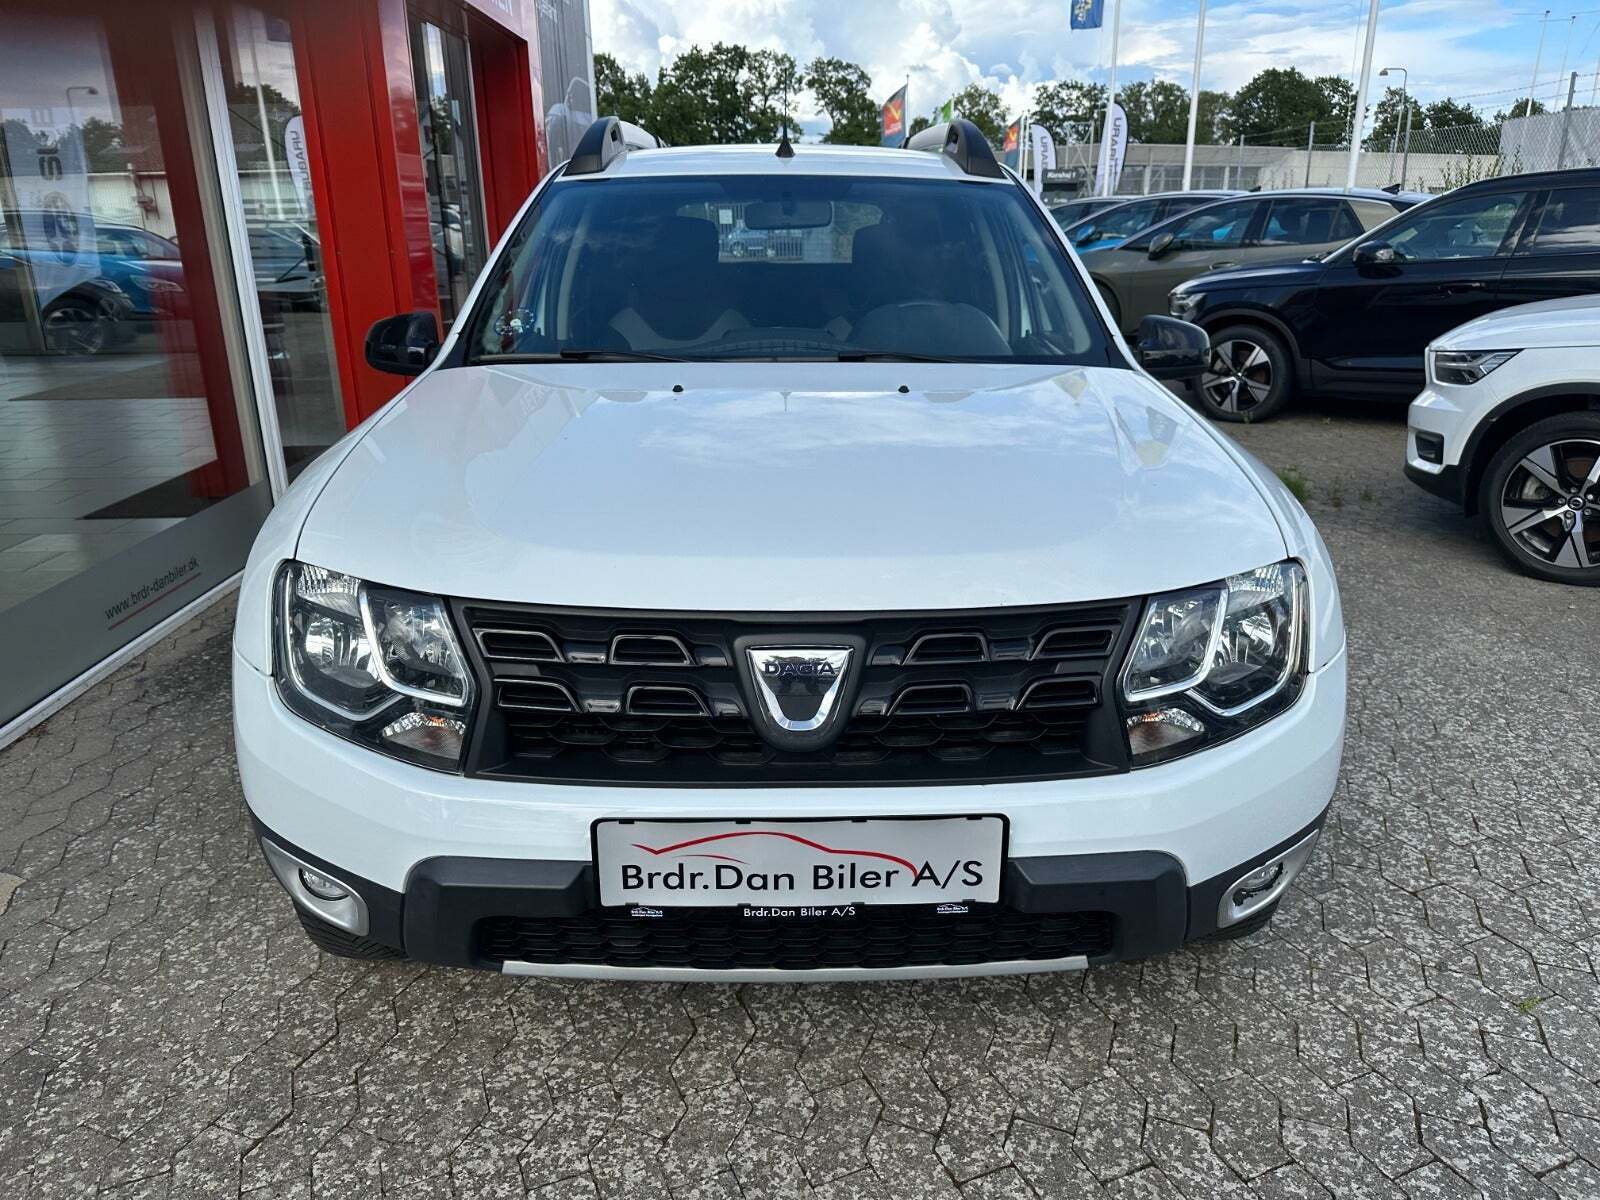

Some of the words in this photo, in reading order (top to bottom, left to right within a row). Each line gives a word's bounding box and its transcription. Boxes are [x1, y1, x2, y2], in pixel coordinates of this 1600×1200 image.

[104, 556, 200, 620] www.brdr-danbiler.dk
[764, 660, 836, 675] DACIA
[622, 863, 794, 890] Brdr.Dan
[814, 863, 899, 889] Biler
[912, 860, 982, 889] A/S
[744, 907, 796, 917] Brdr.Dan
[800, 906, 827, 917] Biler
[831, 906, 856, 917] A/S
